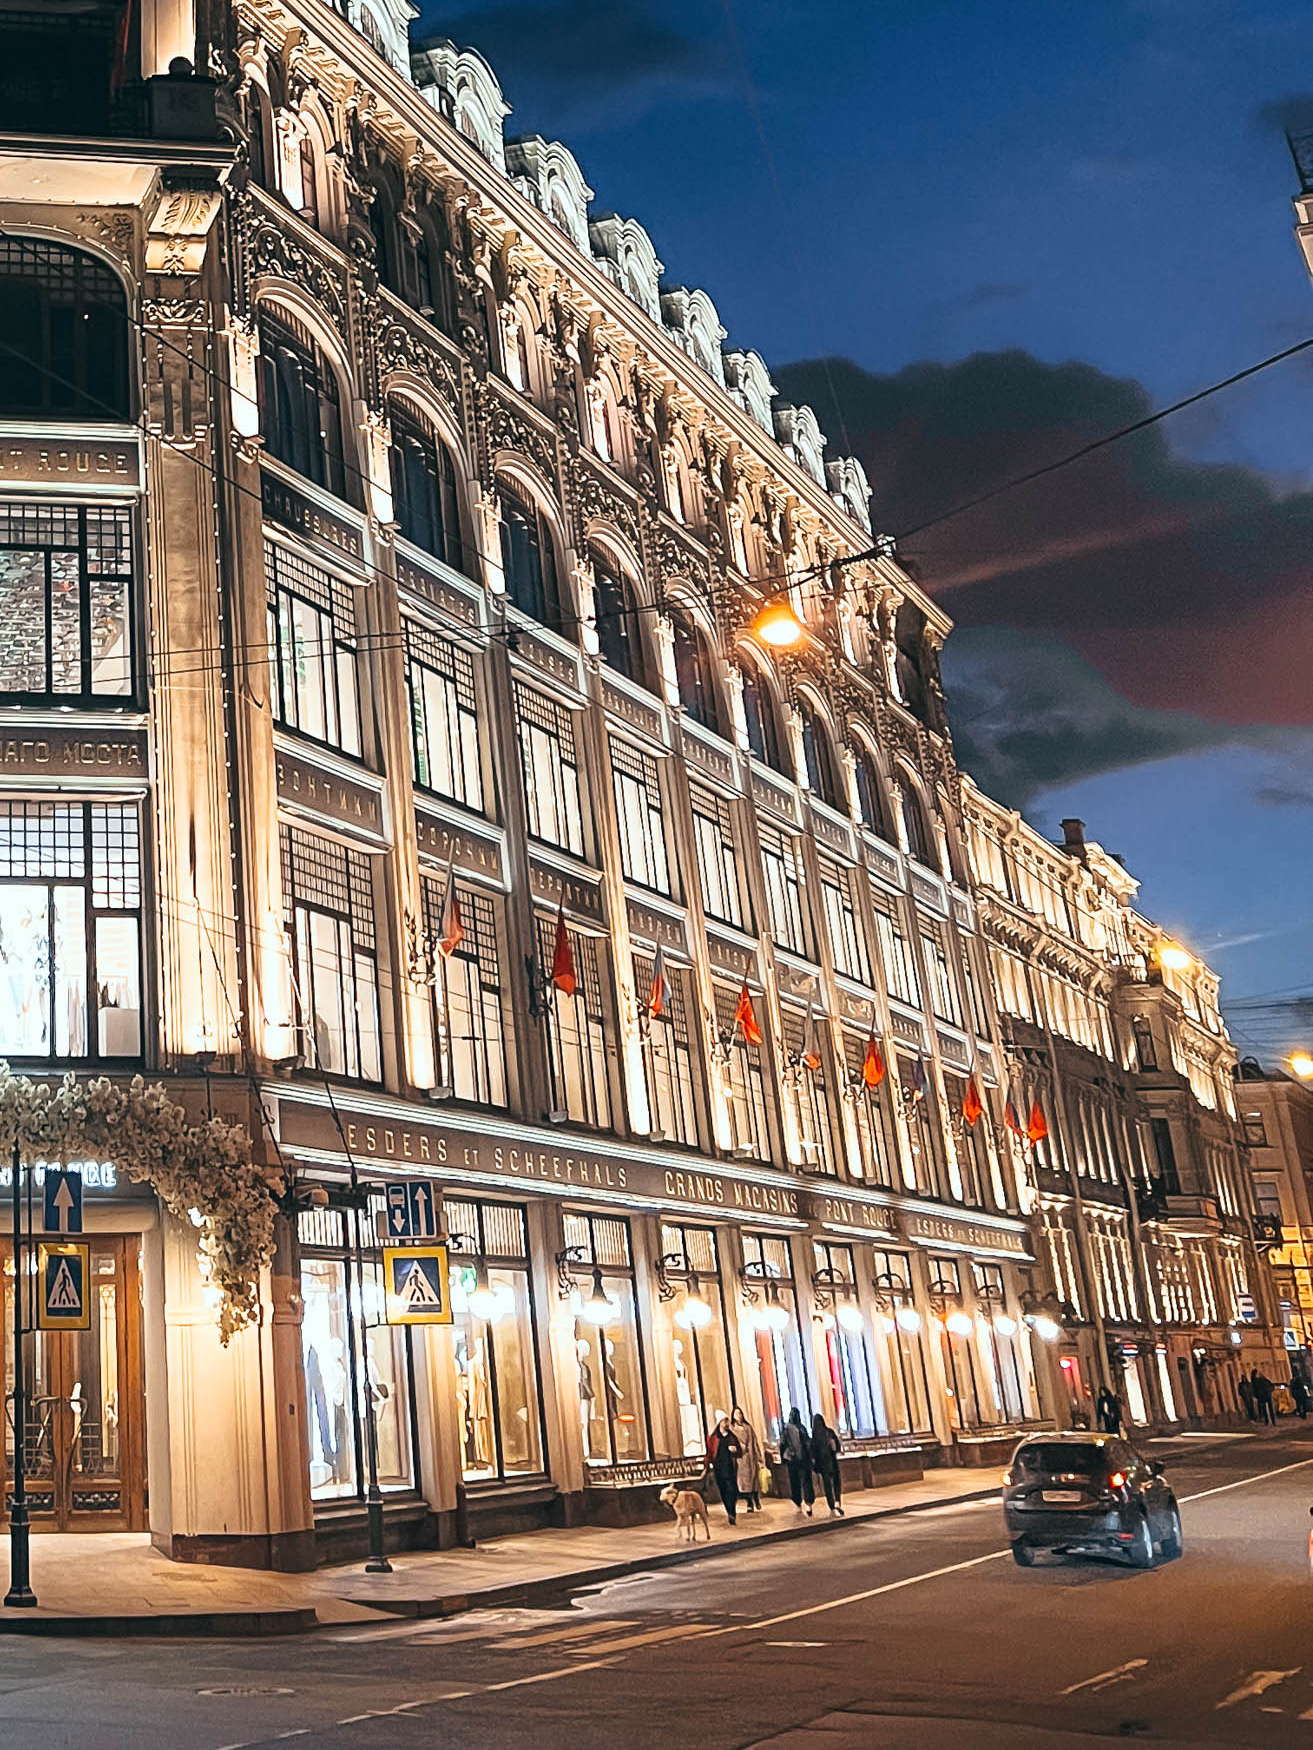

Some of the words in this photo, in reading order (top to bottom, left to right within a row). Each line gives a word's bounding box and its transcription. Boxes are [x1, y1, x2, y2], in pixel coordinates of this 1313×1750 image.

[38, 451, 128, 474] ROUGE
[63, 740, 142, 766] МОСТА
[277, 763, 377, 822] ЗОНТИКИ
[348, 1123, 448, 1163] ESDERS
[463, 1147, 479, 1166] ET
[494, 1147, 628, 1188] SCHEEFHALS
[664, 1170, 724, 1204] GRANDS
[734, 1181, 799, 1215] MAGASINS
[825, 1198, 855, 1224] PONT
